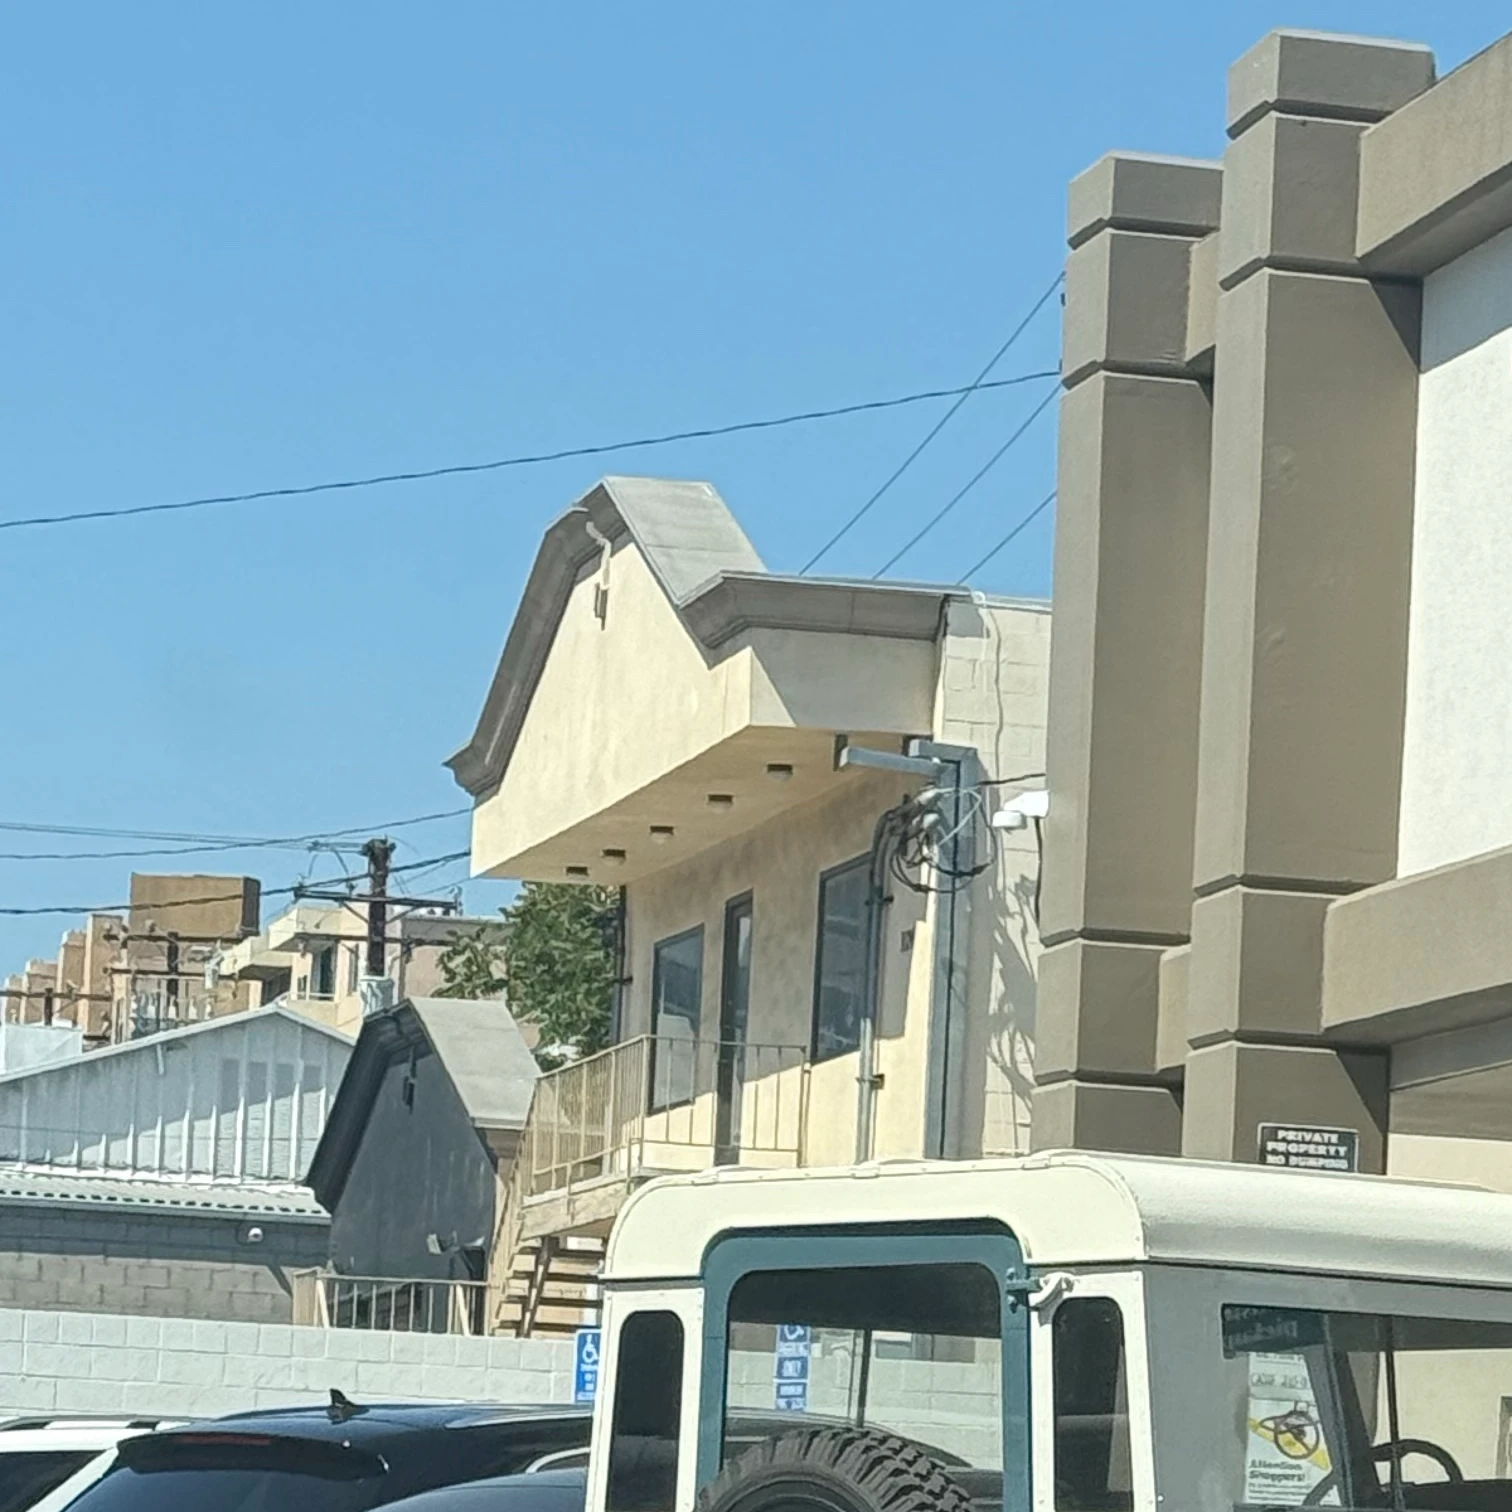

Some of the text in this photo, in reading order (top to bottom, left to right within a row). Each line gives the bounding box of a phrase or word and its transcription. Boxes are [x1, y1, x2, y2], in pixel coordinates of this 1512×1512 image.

[1277, 1130, 1339, 1144] PRIVATE
[1266, 1141, 1348, 1157] PROPERTY
[1265, 1153, 1286, 1165] NO
[1249, 1459, 1303, 1471] Attention
